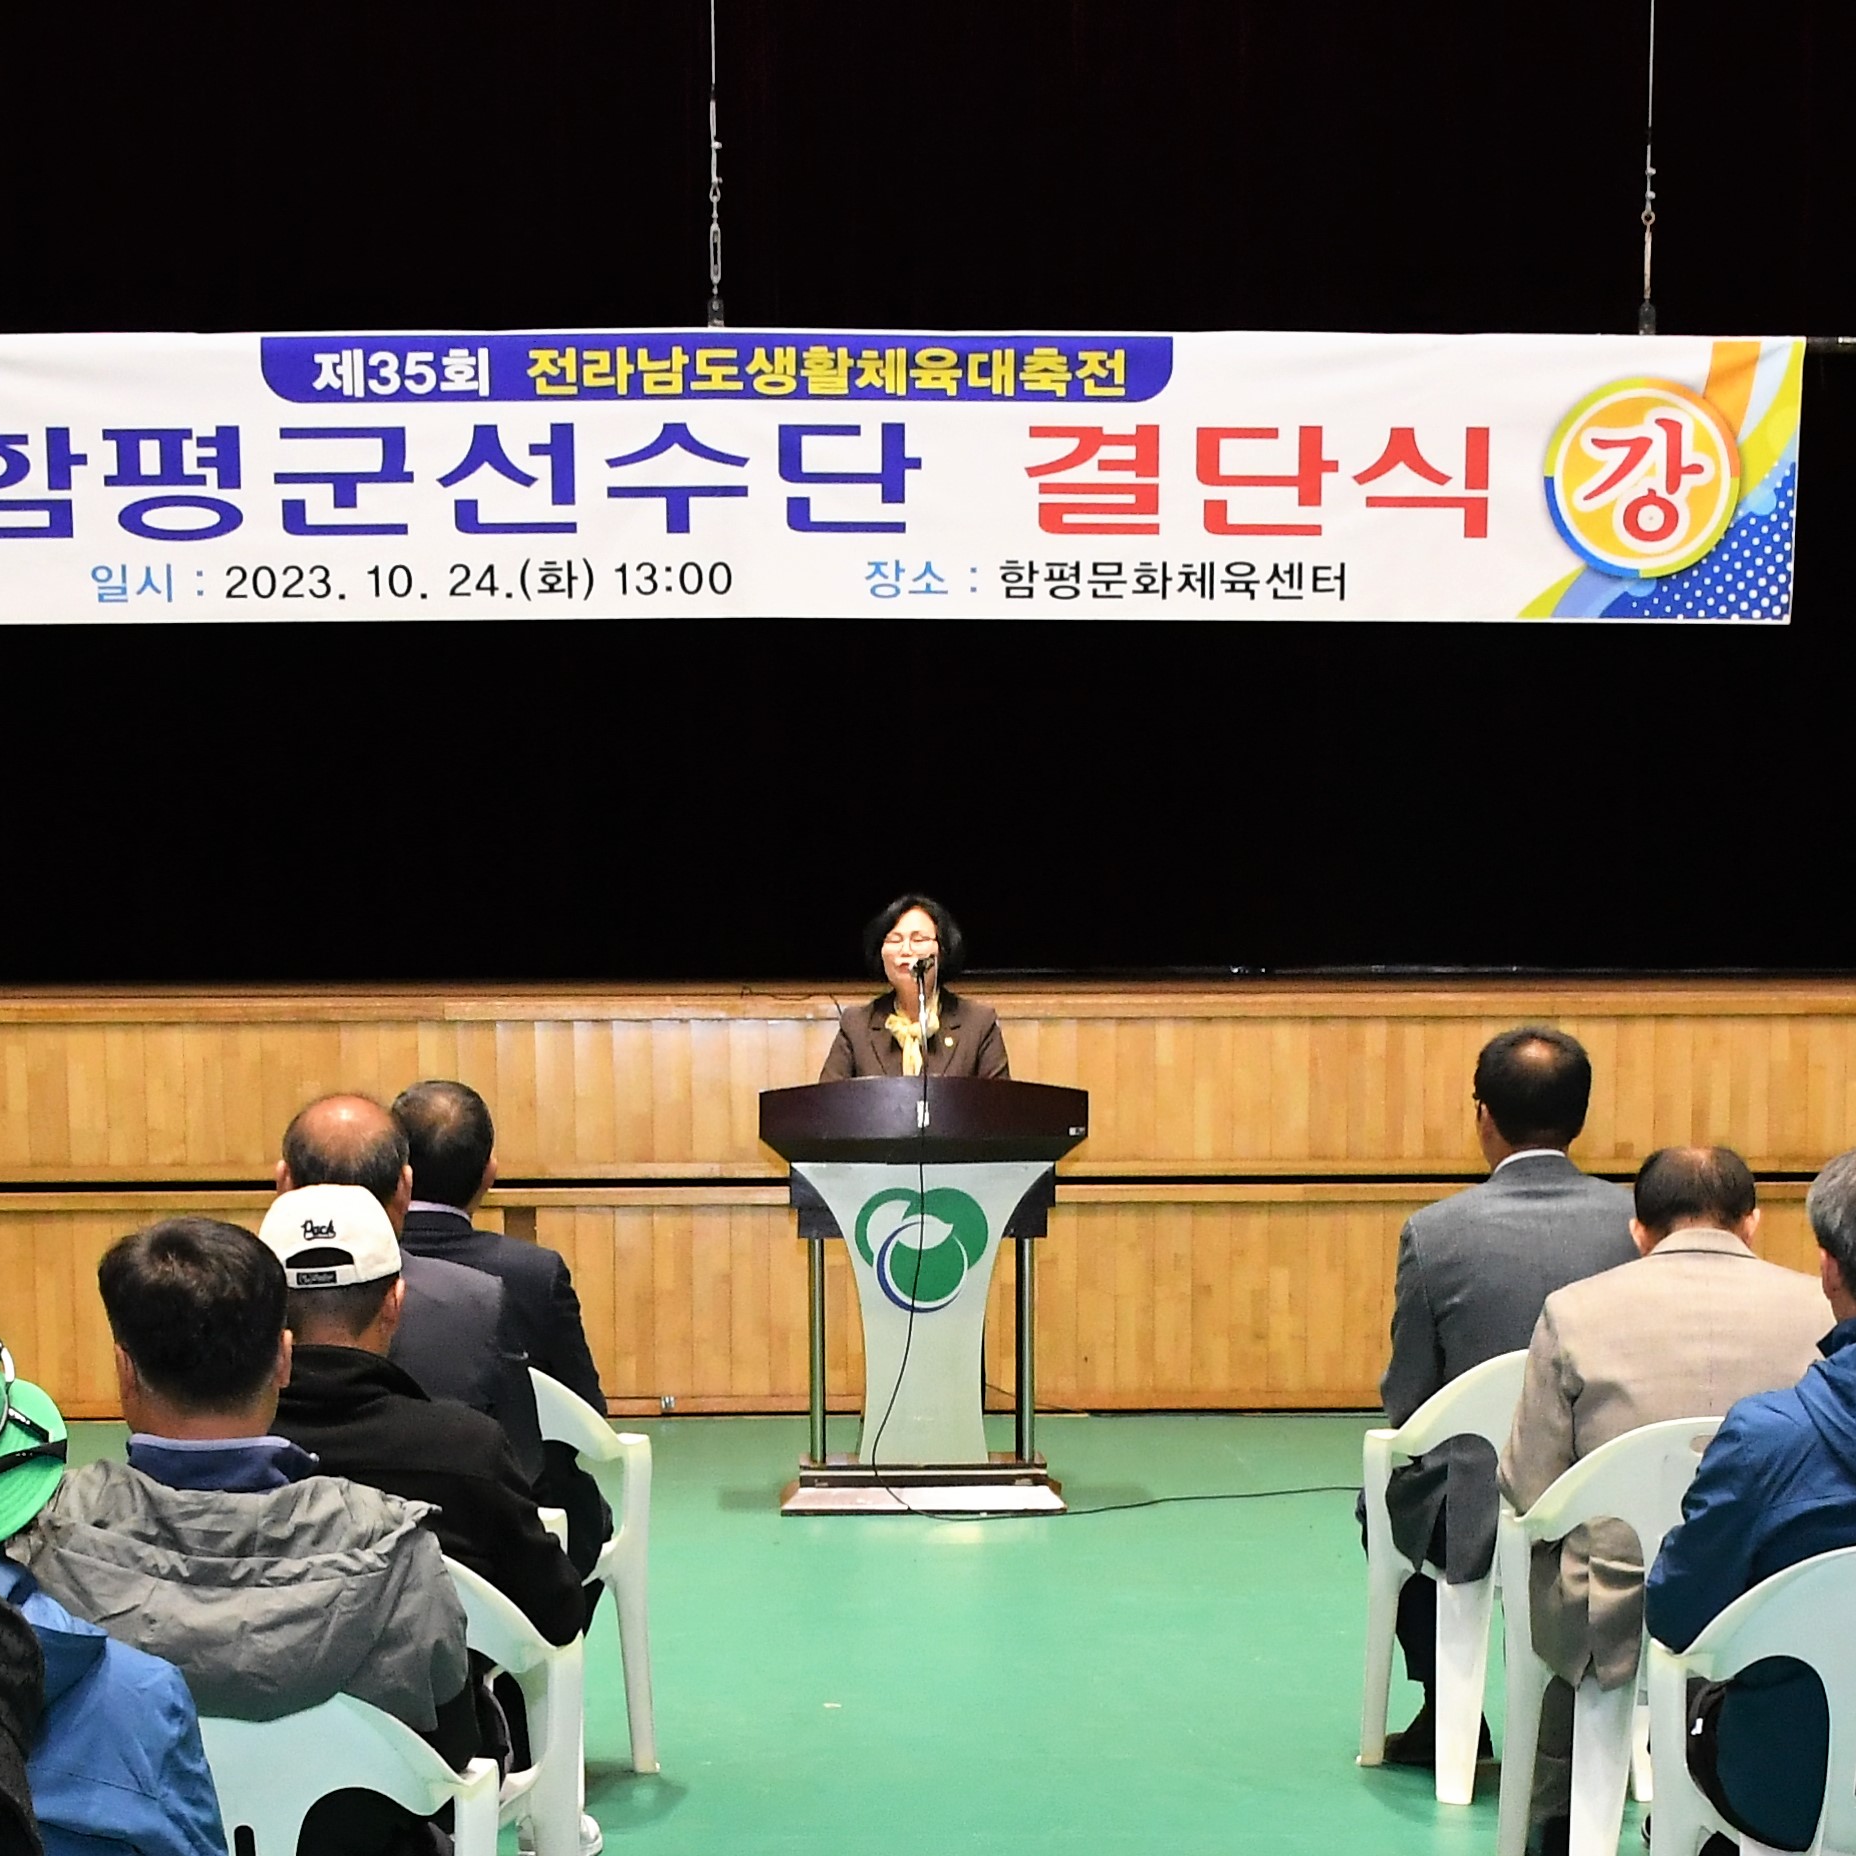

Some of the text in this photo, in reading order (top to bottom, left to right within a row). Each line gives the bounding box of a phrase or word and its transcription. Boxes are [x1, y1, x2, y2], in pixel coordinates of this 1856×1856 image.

[311, 347, 1128, 399] 제35회 전라남도생활체육대축전
[1024, 422, 1492, 540] 결단식
[1584, 418, 1714, 543] 강
[89, 562, 174, 604] 일시
[225, 564, 347, 600] 2023.
[366, 564, 429, 600] 10.
[613, 561, 733, 597] 13:00
[863, 559, 950, 600] 장소
[998, 559, 1347, 602] 함평문화체육센터
